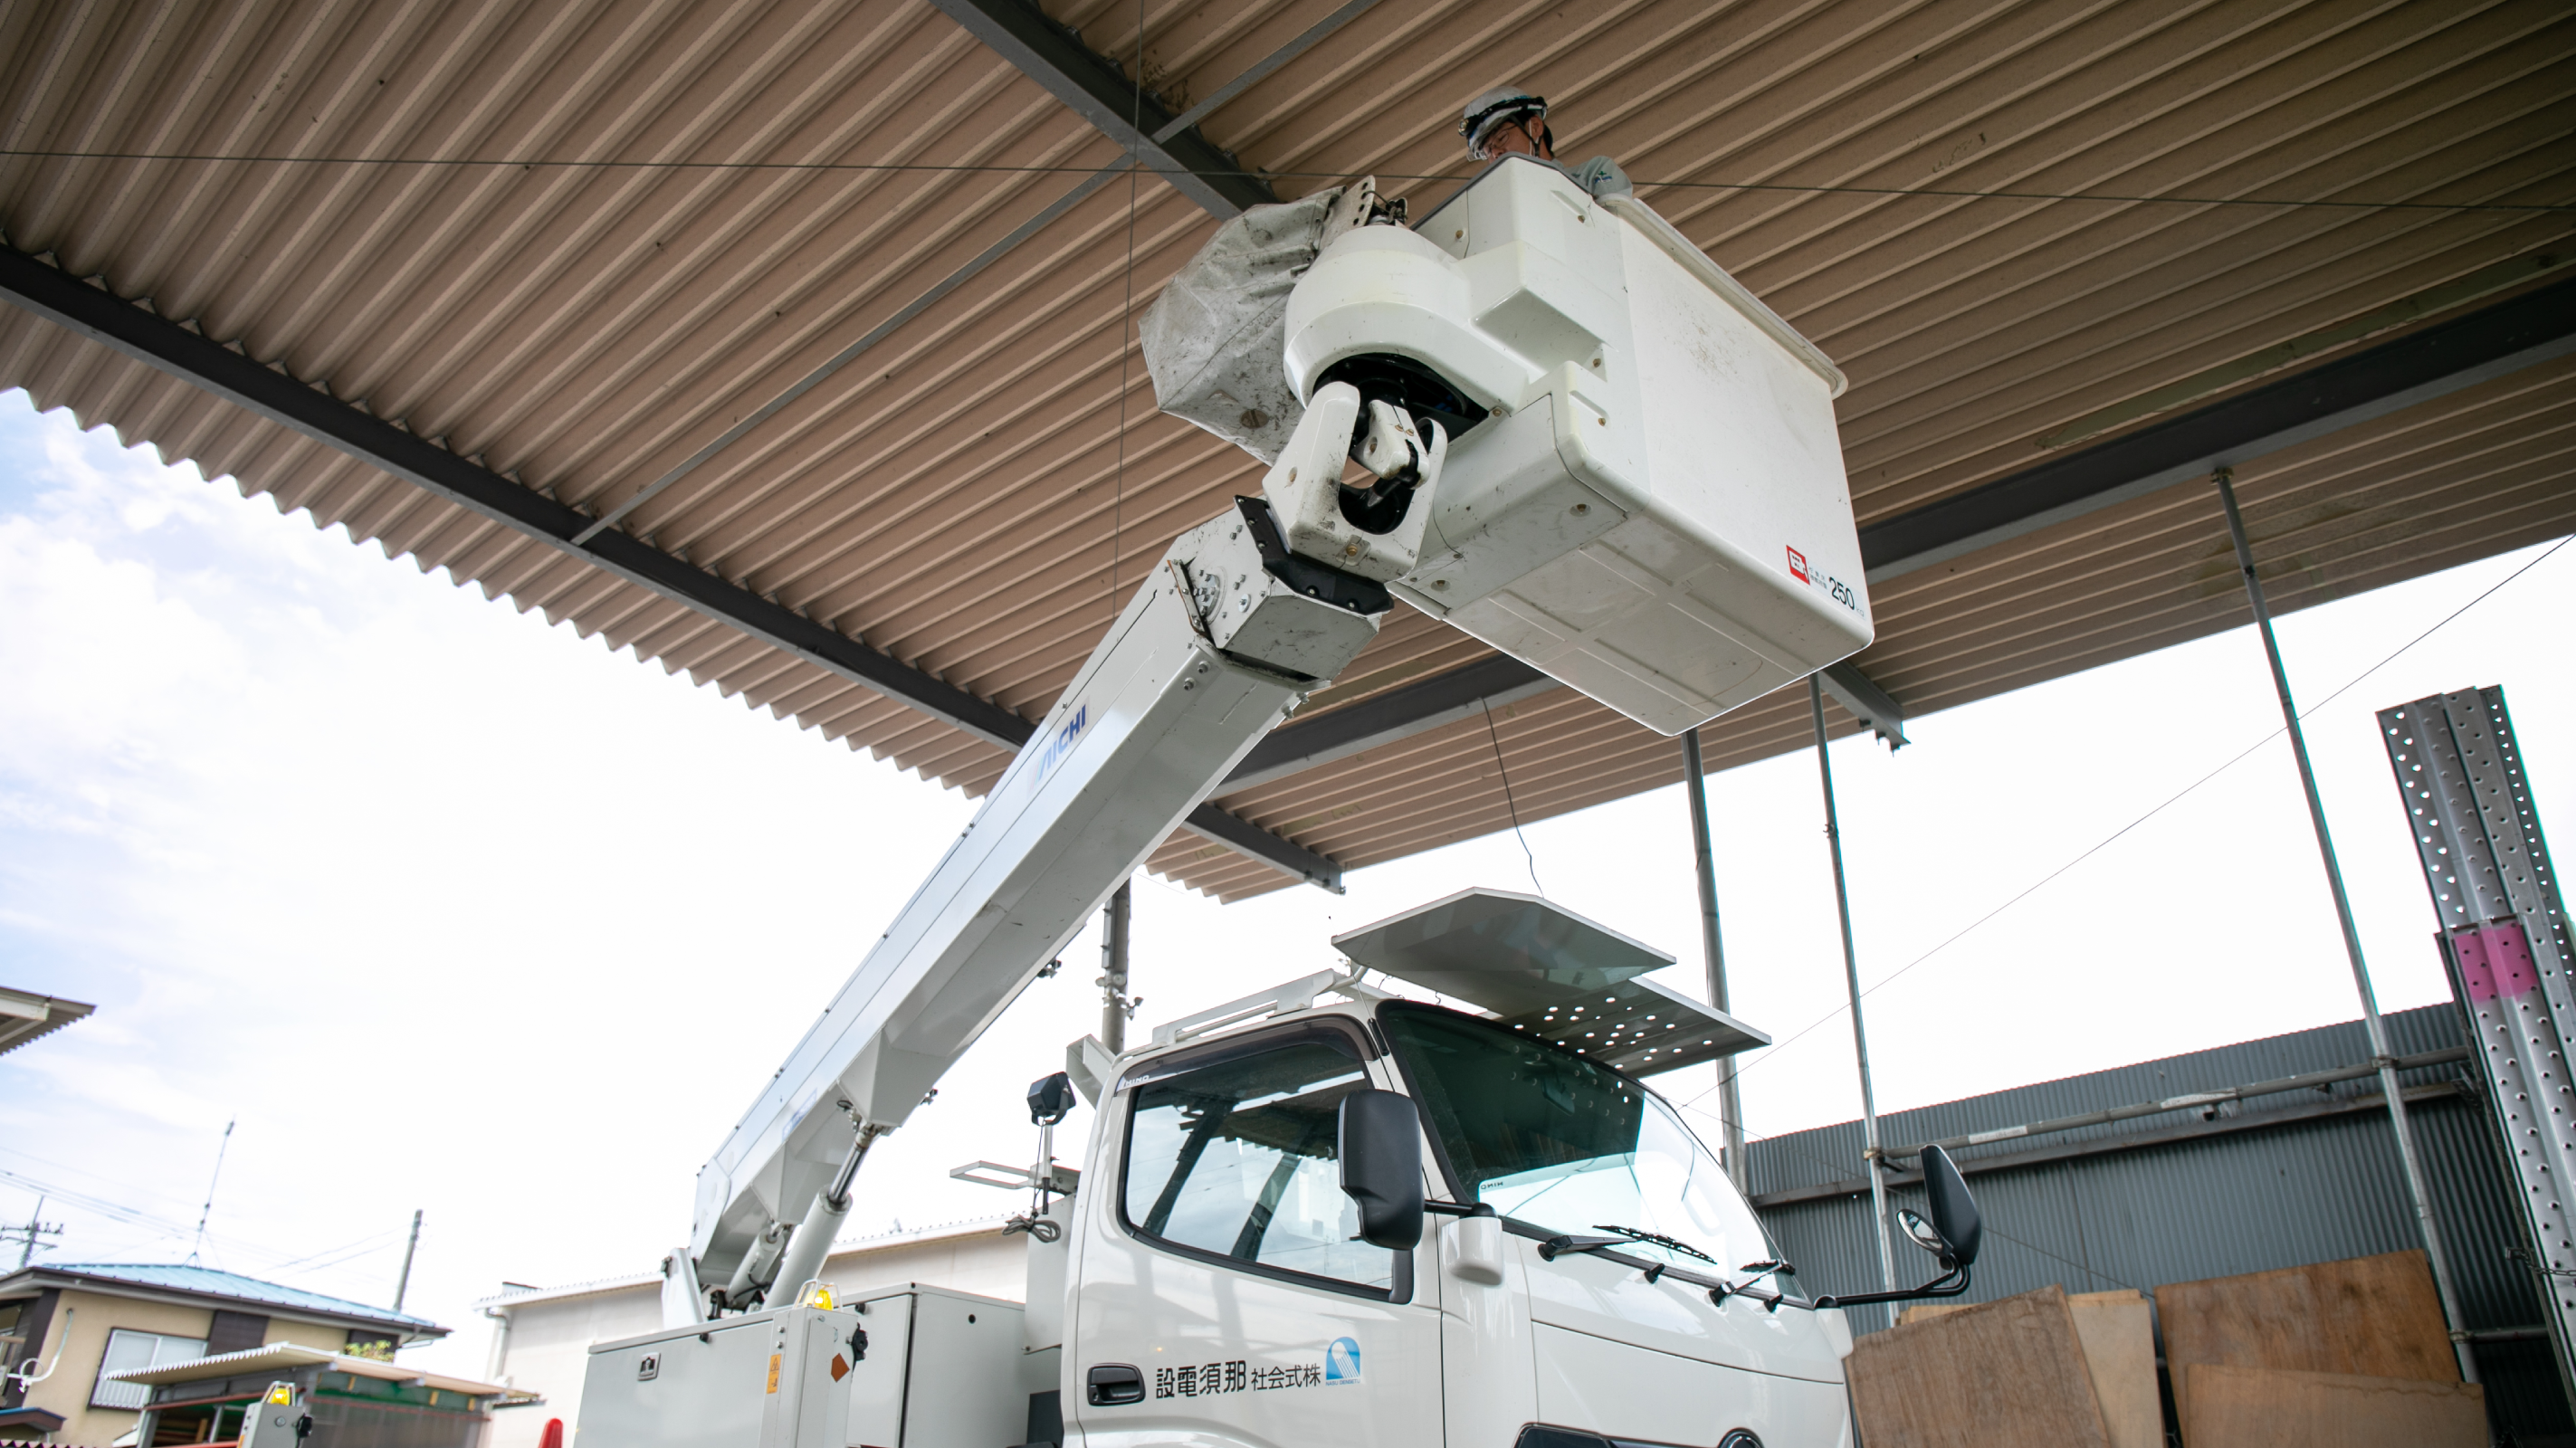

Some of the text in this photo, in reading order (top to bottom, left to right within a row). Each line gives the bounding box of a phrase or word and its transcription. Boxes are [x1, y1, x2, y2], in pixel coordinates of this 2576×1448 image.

[1828, 576, 1855, 611] 250
[1037, 704, 1086, 782] AICHI
[1125, 1074, 1150, 1086] HINO
